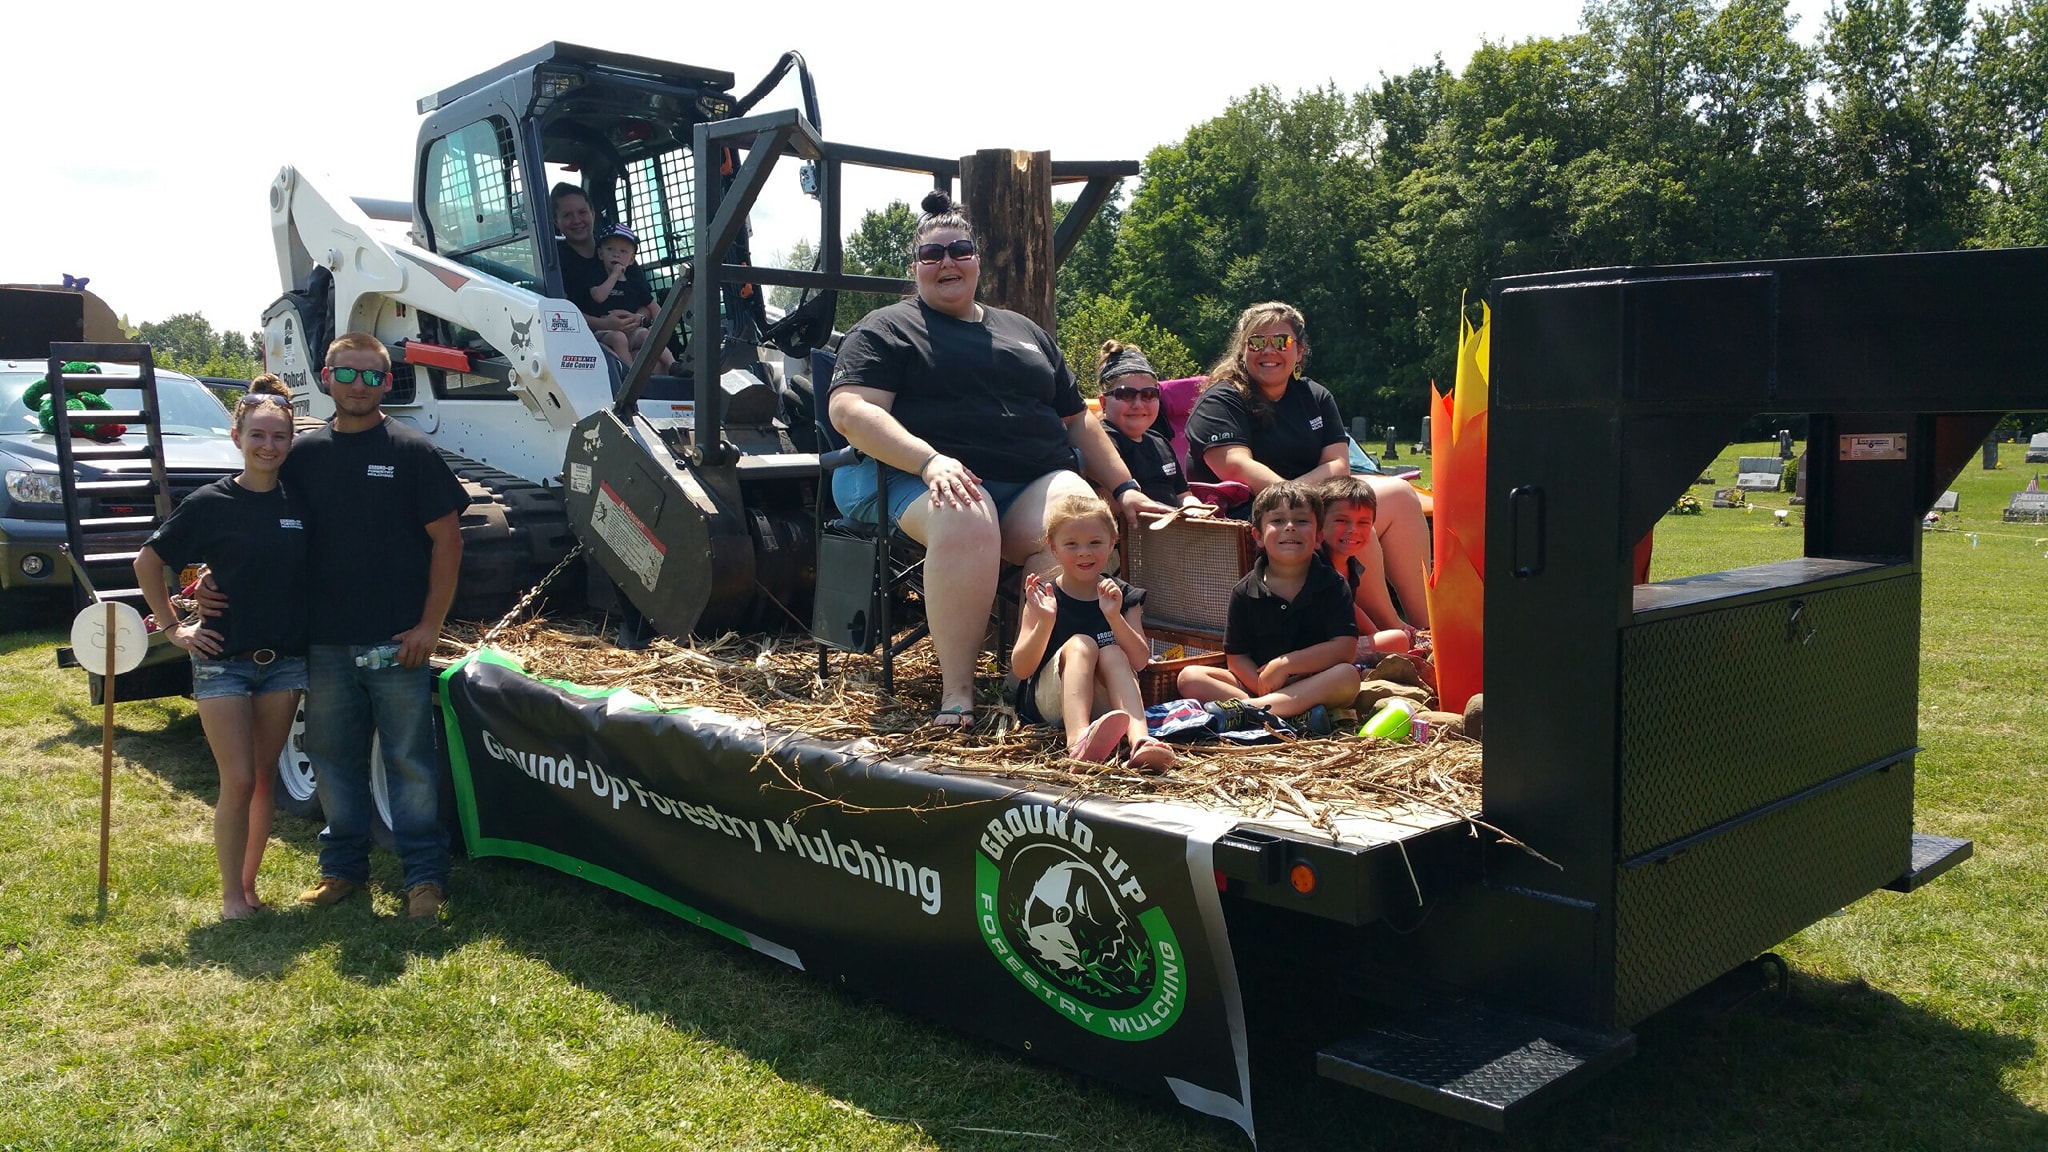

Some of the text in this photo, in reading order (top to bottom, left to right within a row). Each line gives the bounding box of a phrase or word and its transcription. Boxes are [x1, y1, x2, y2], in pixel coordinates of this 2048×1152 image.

[283, 369, 307, 388] Bobcat
[624, 504, 646, 530] DANGER
[482, 729, 942, 915] Ground-Up Forestry Mulching
[980, 804, 1148, 904] GROUND-UP
[980, 892, 1096, 1024] FORESTRY
[1107, 940, 1180, 1034] MULCHING
